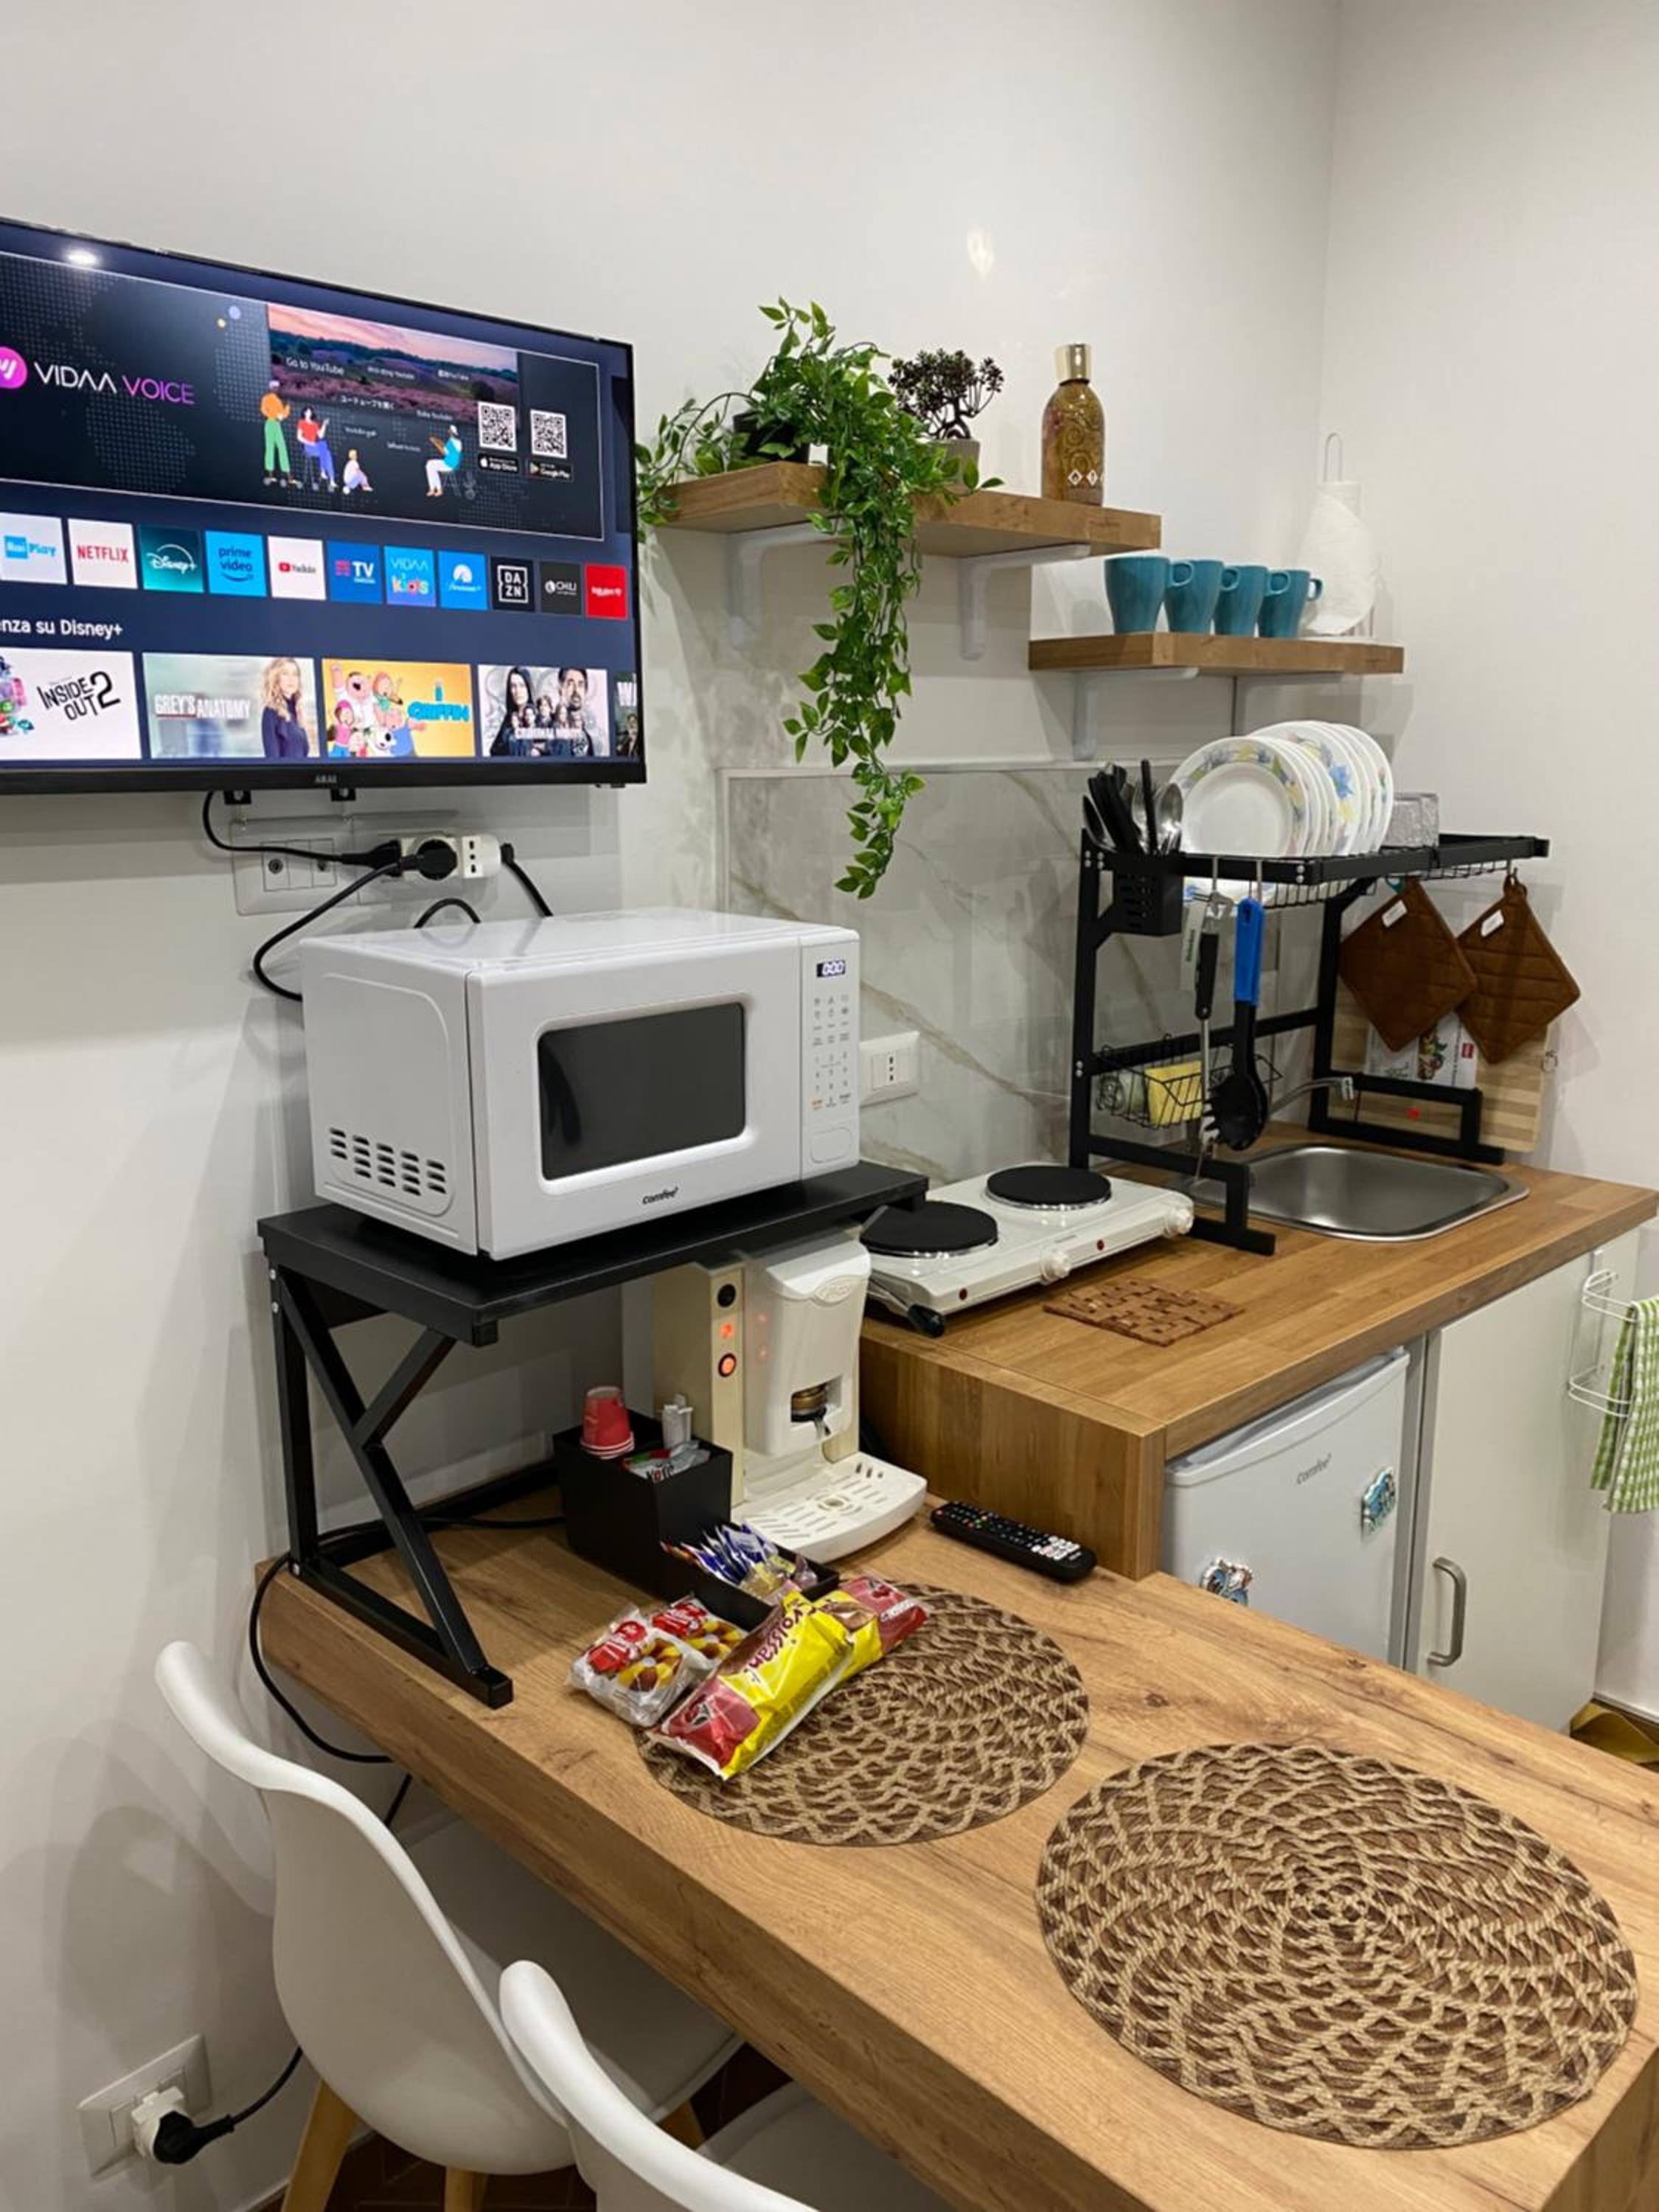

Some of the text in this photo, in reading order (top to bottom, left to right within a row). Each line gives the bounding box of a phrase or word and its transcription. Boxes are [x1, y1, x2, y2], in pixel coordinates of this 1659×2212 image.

[34, 362, 194, 404] VIDAA VOICE
[77, 545, 128, 563] NETFLIX
[219, 547, 252, 558] prime
[220, 560, 253, 571] video
[352, 561, 374, 578] TV
[0, 619, 123, 640] nza su Disney+
[37, 670, 121, 709] INSIDE 2
[64, 695, 98, 720] OUT
[155, 695, 250, 719] GREY'S ANATOMY
